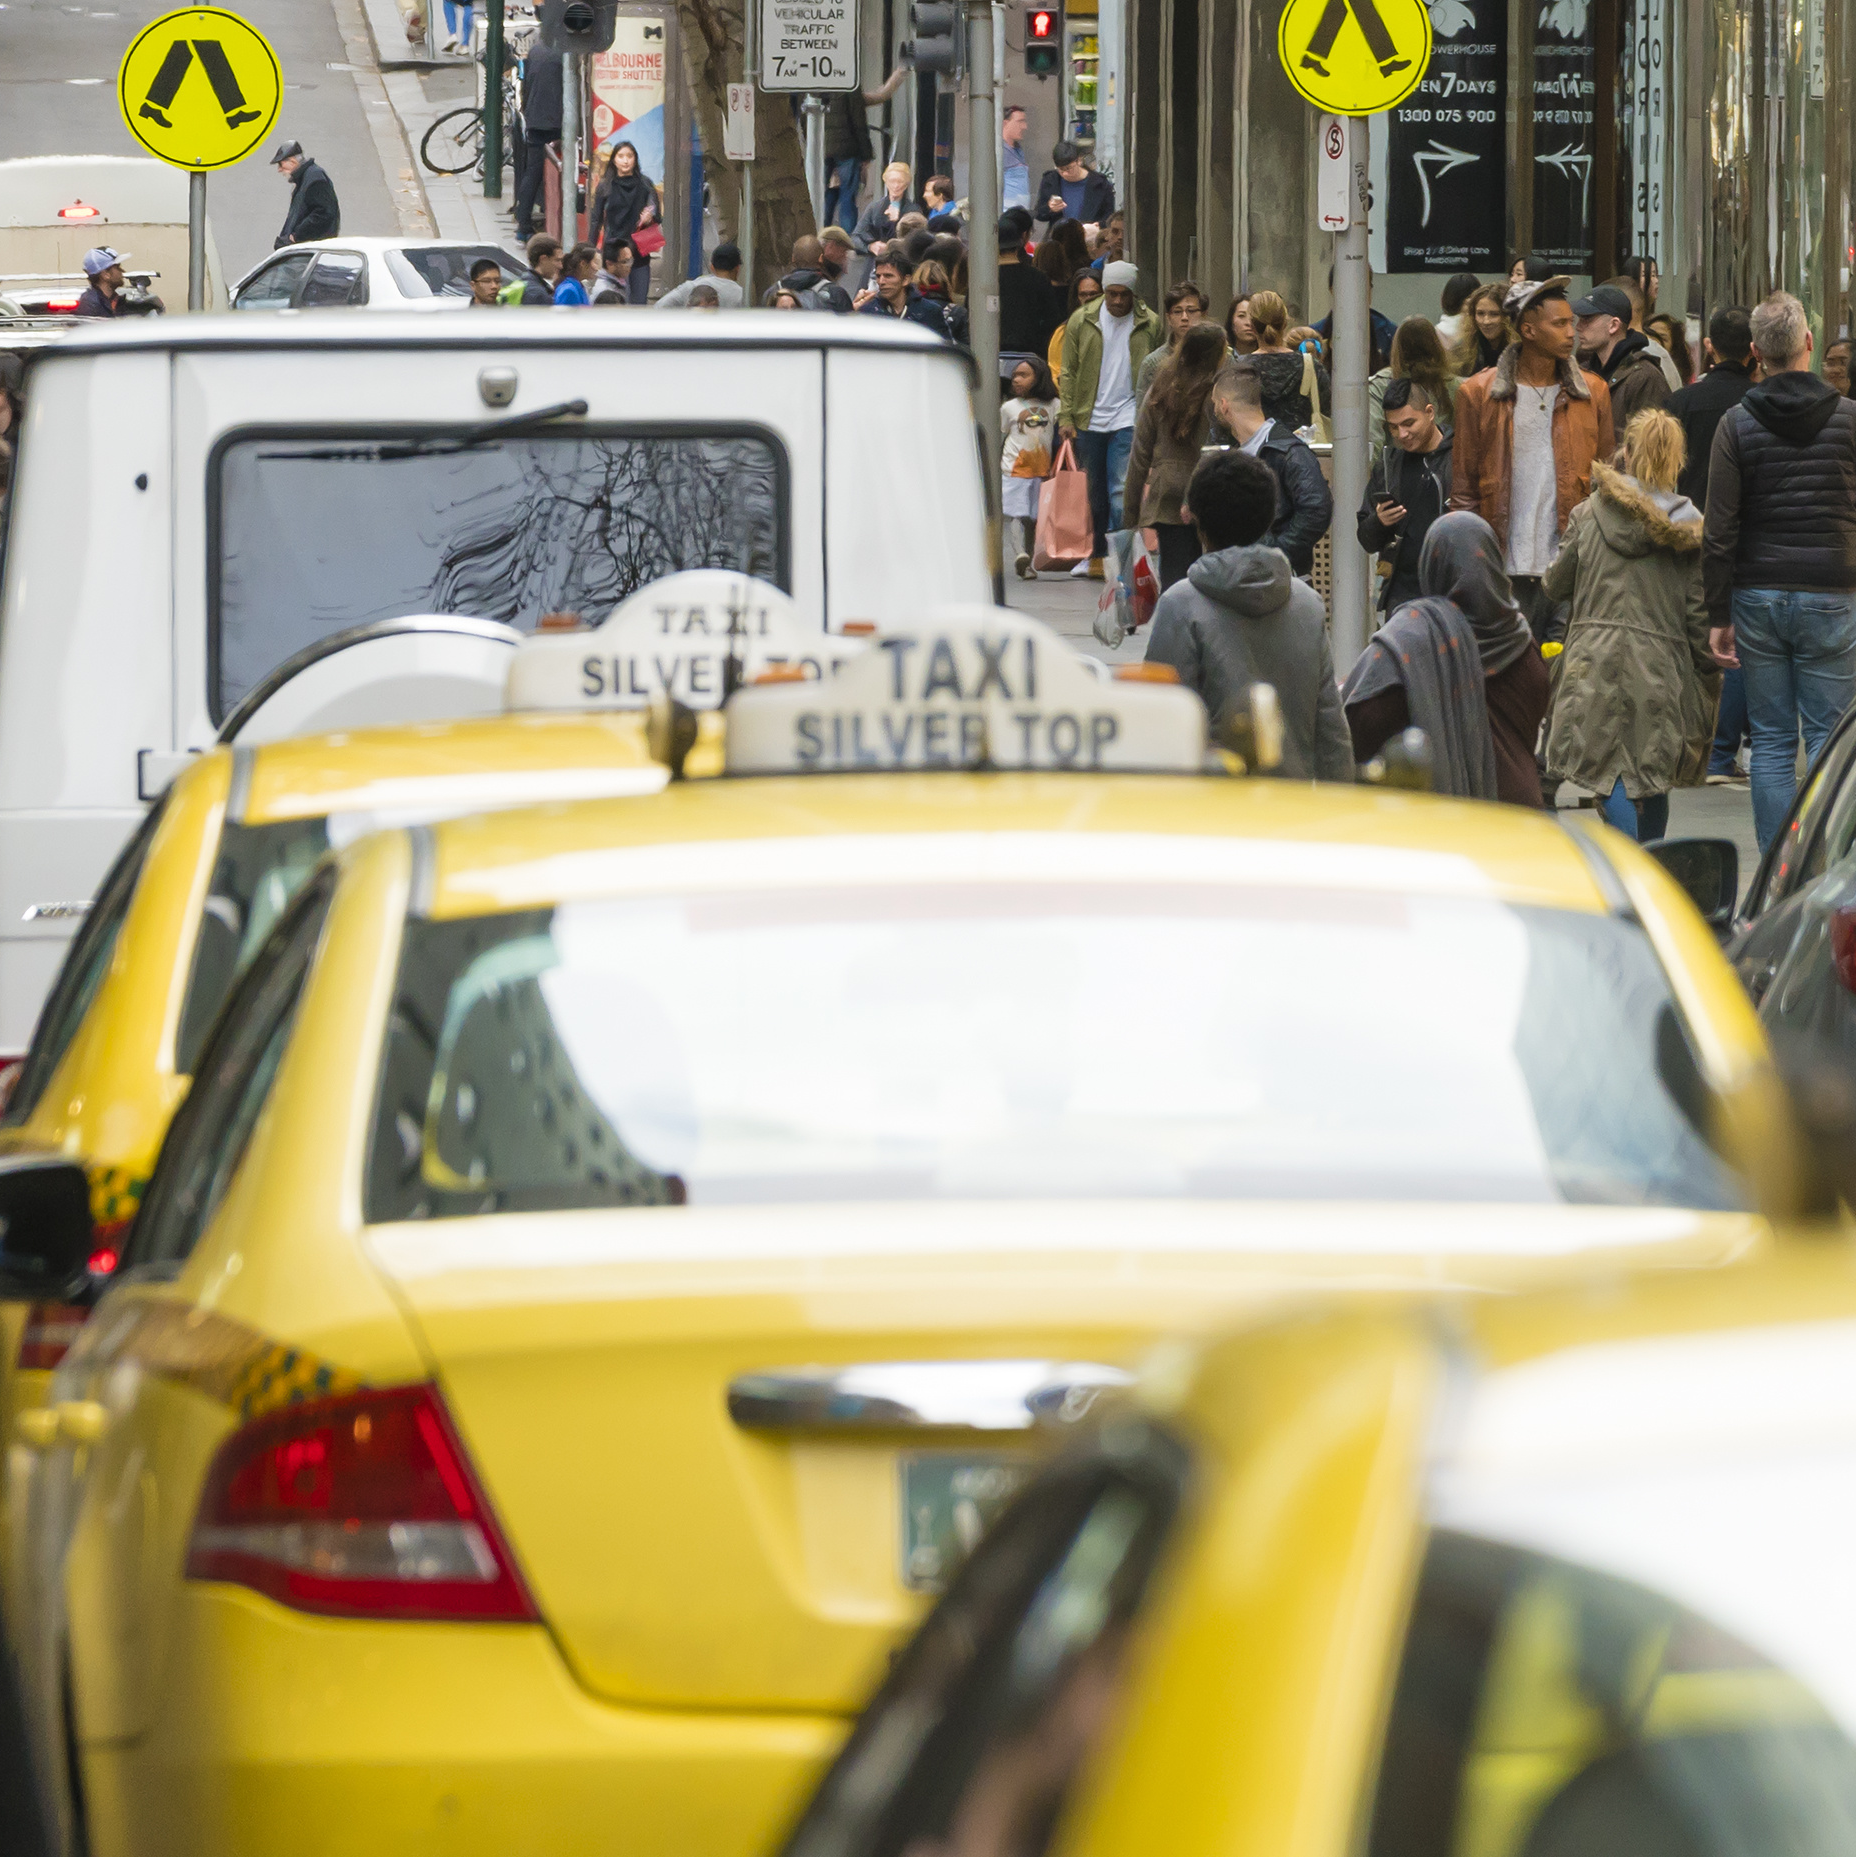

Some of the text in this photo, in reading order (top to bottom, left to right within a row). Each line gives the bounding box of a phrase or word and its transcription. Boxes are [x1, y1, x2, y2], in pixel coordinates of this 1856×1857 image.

[774, 8, 845, 20] VEHICULAR
[783, 23, 836, 35] TRAFFIC
[780, 39, 839, 50] BETWEEN
[622, 69, 663, 81] SHUTTLE
[1456, 79, 1497, 94] DAYS
[1397, 109, 1496, 123] 1300 075 900
[1424, 256, 1469, 264] Melbourne
[652, 604, 771, 637] TAXI
[879, 636, 1039, 702] TAXI
[1011, 712, 1121, 770] TOP
